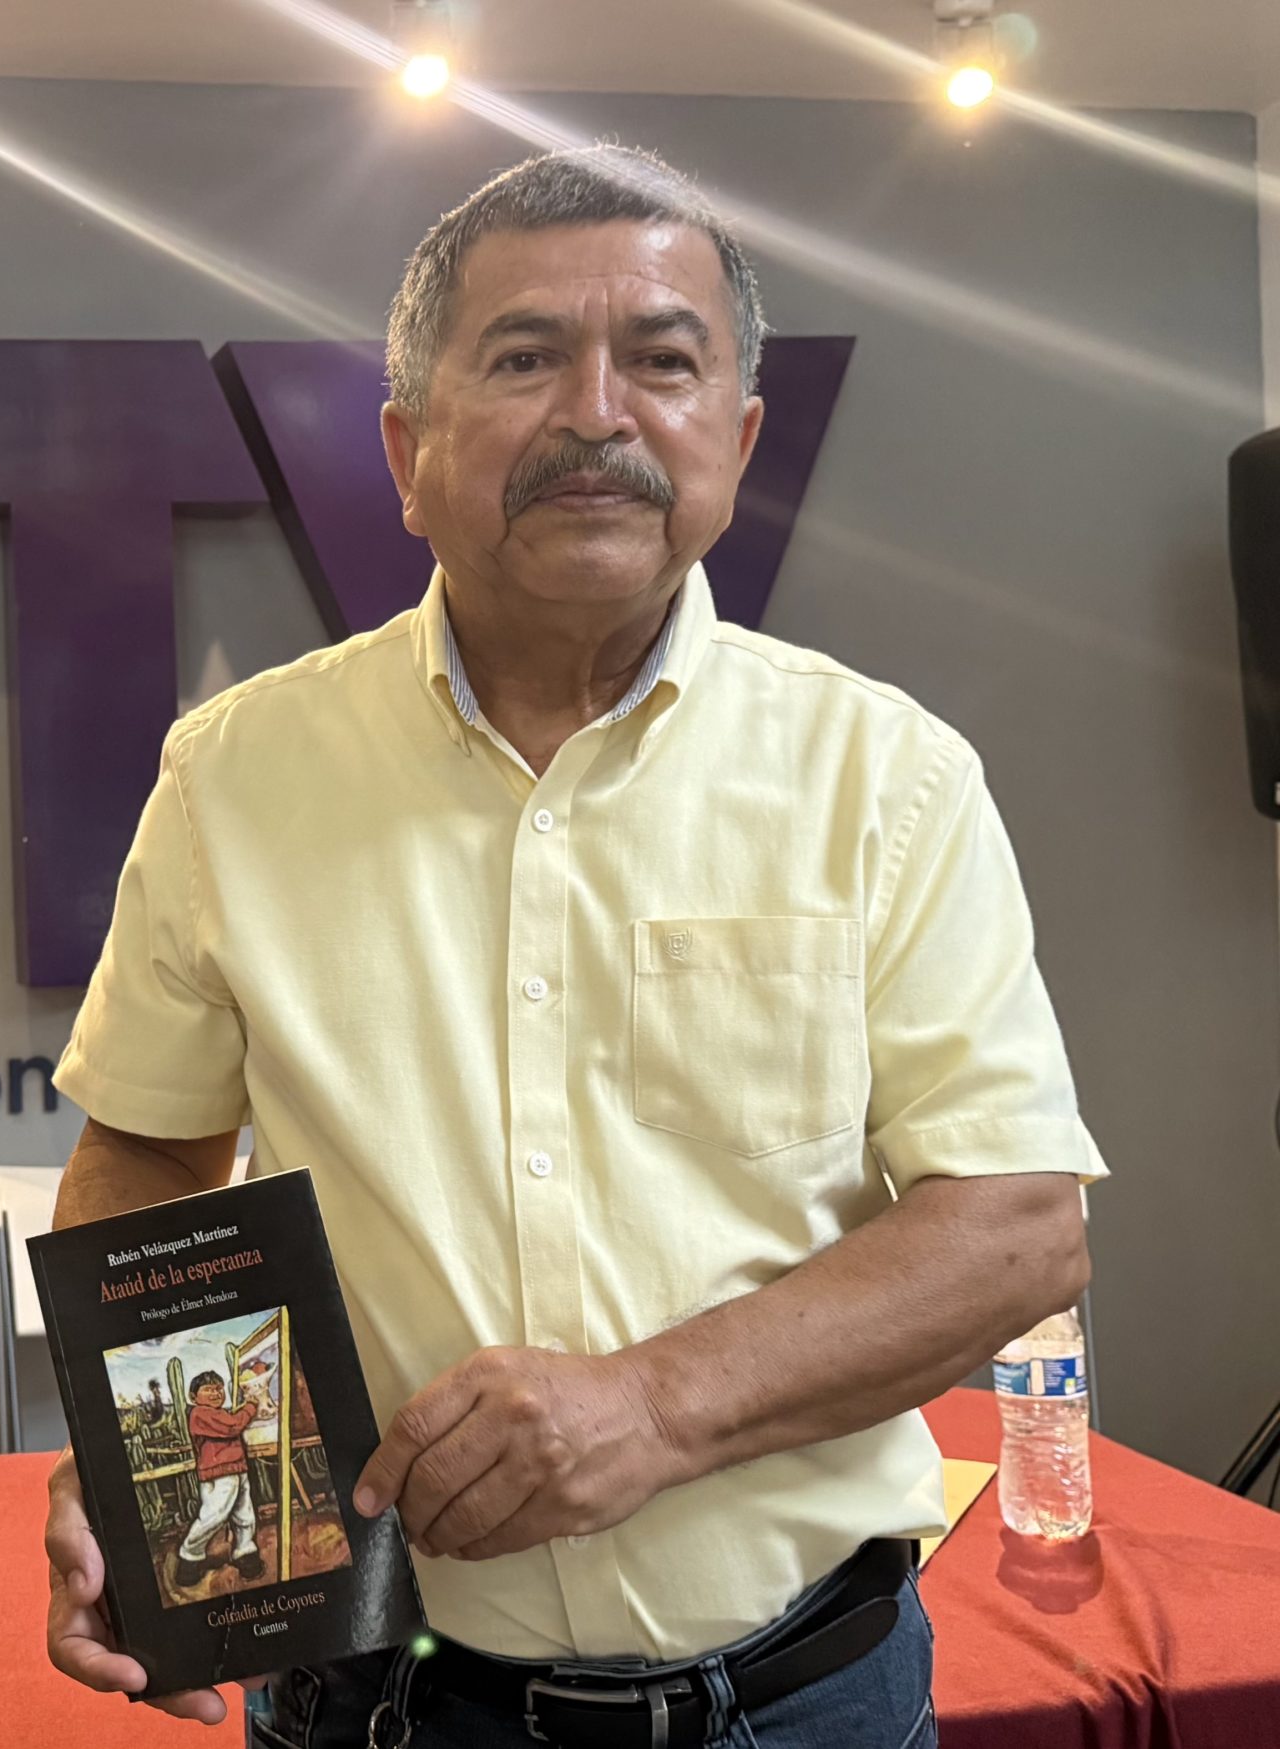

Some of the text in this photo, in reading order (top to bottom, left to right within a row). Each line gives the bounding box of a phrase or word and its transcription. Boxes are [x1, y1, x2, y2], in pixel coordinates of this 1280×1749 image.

[107, 1224, 239, 1267] Rubén Velázquez Martínez
[100, 1248, 264, 1304] Ataúd de la esperanza
[140, 1290, 239, 1322] Prólogo de Élmer Mendoza
[260, 1599, 275, 1616] de
[277, 1591, 326, 1614] Coyotes
[253, 1620, 289, 1637] Cuentos
